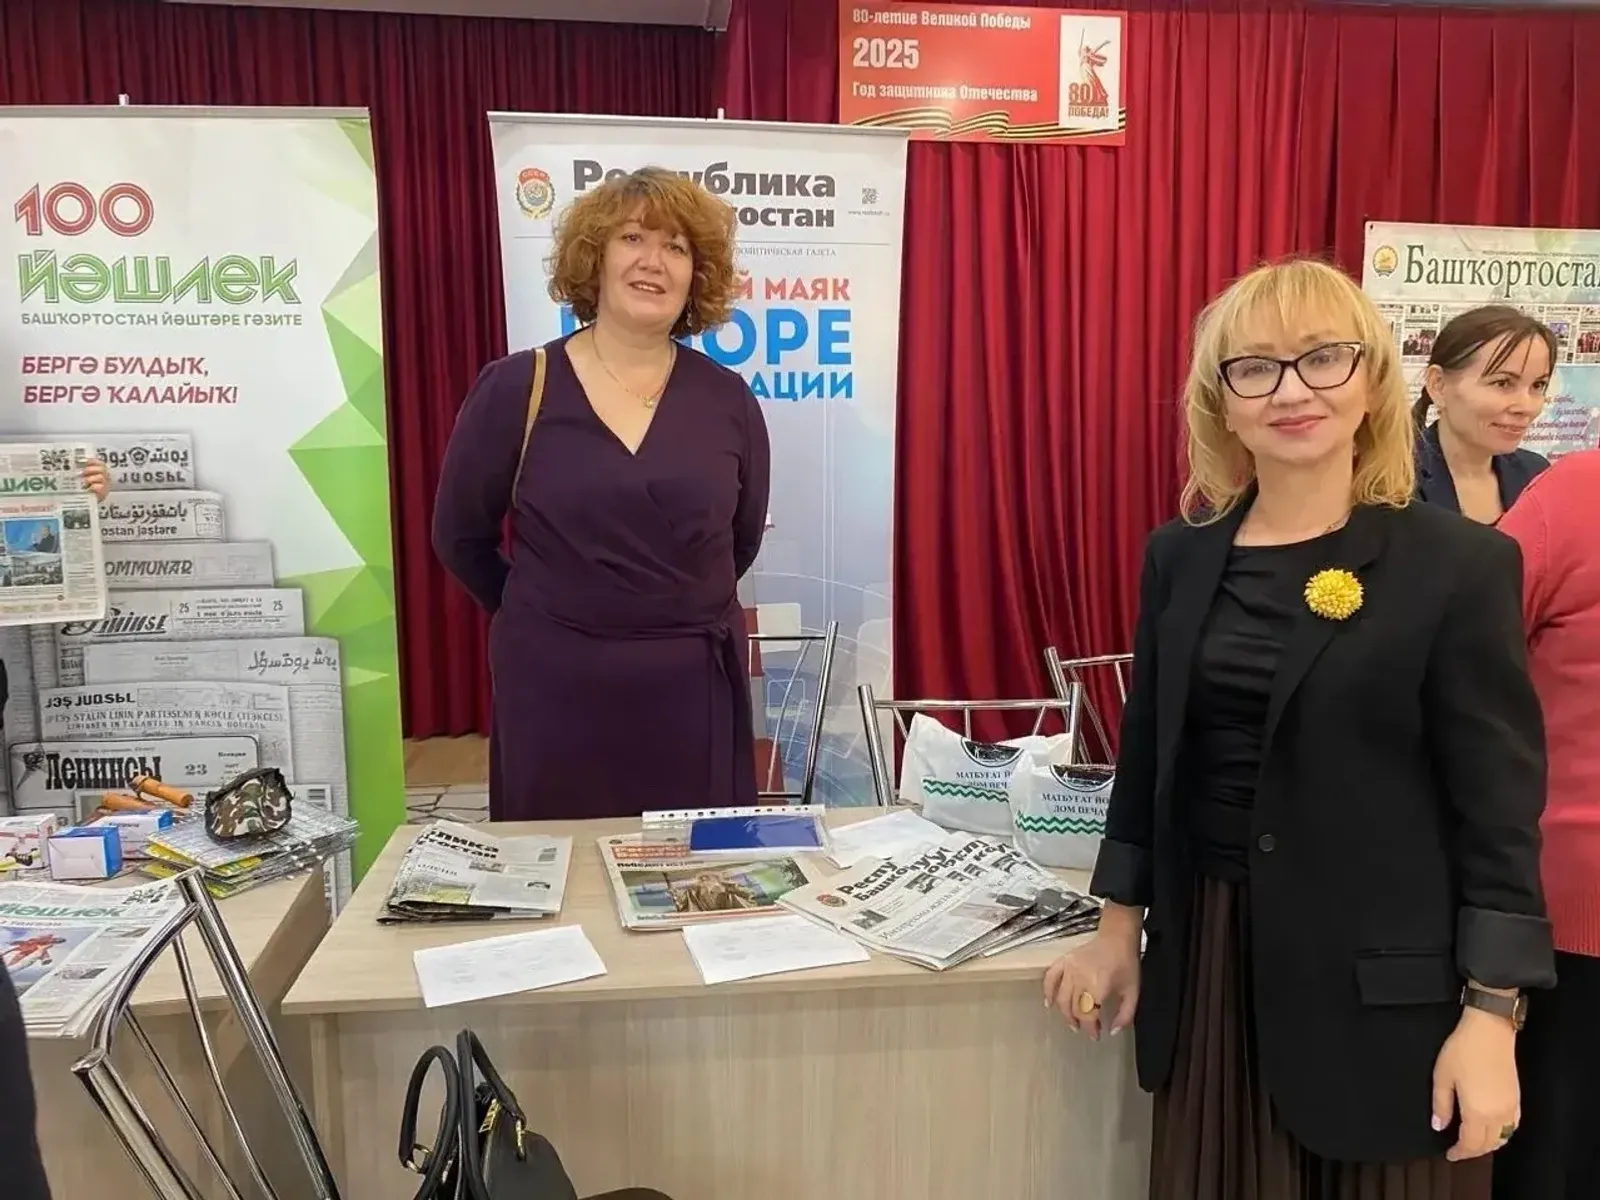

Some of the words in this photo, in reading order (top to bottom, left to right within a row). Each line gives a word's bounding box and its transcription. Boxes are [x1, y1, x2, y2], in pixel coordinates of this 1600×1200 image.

[853, 9, 918, 26] 80-летие
[921, 11, 978, 28] Великой
[980, 12, 1031, 30] Победы
[852, 37, 920, 69] 2025
[852, 81, 876, 98] Год
[879, 83, 957, 100] защитника
[960, 85, 1038, 102] Отечества
[1068, 82, 1093, 104] 80
[14, 181, 154, 236] 100
[765, 276, 851, 301] МАЯК
[242, 313, 303, 327] ГӘЗИТЕ
[683, 307, 852, 367] ОРЕ
[21, 355, 99, 375] БЕРГӘ
[23, 385, 101, 404] БЕРГӘ
[185, 763, 208, 776] 23
